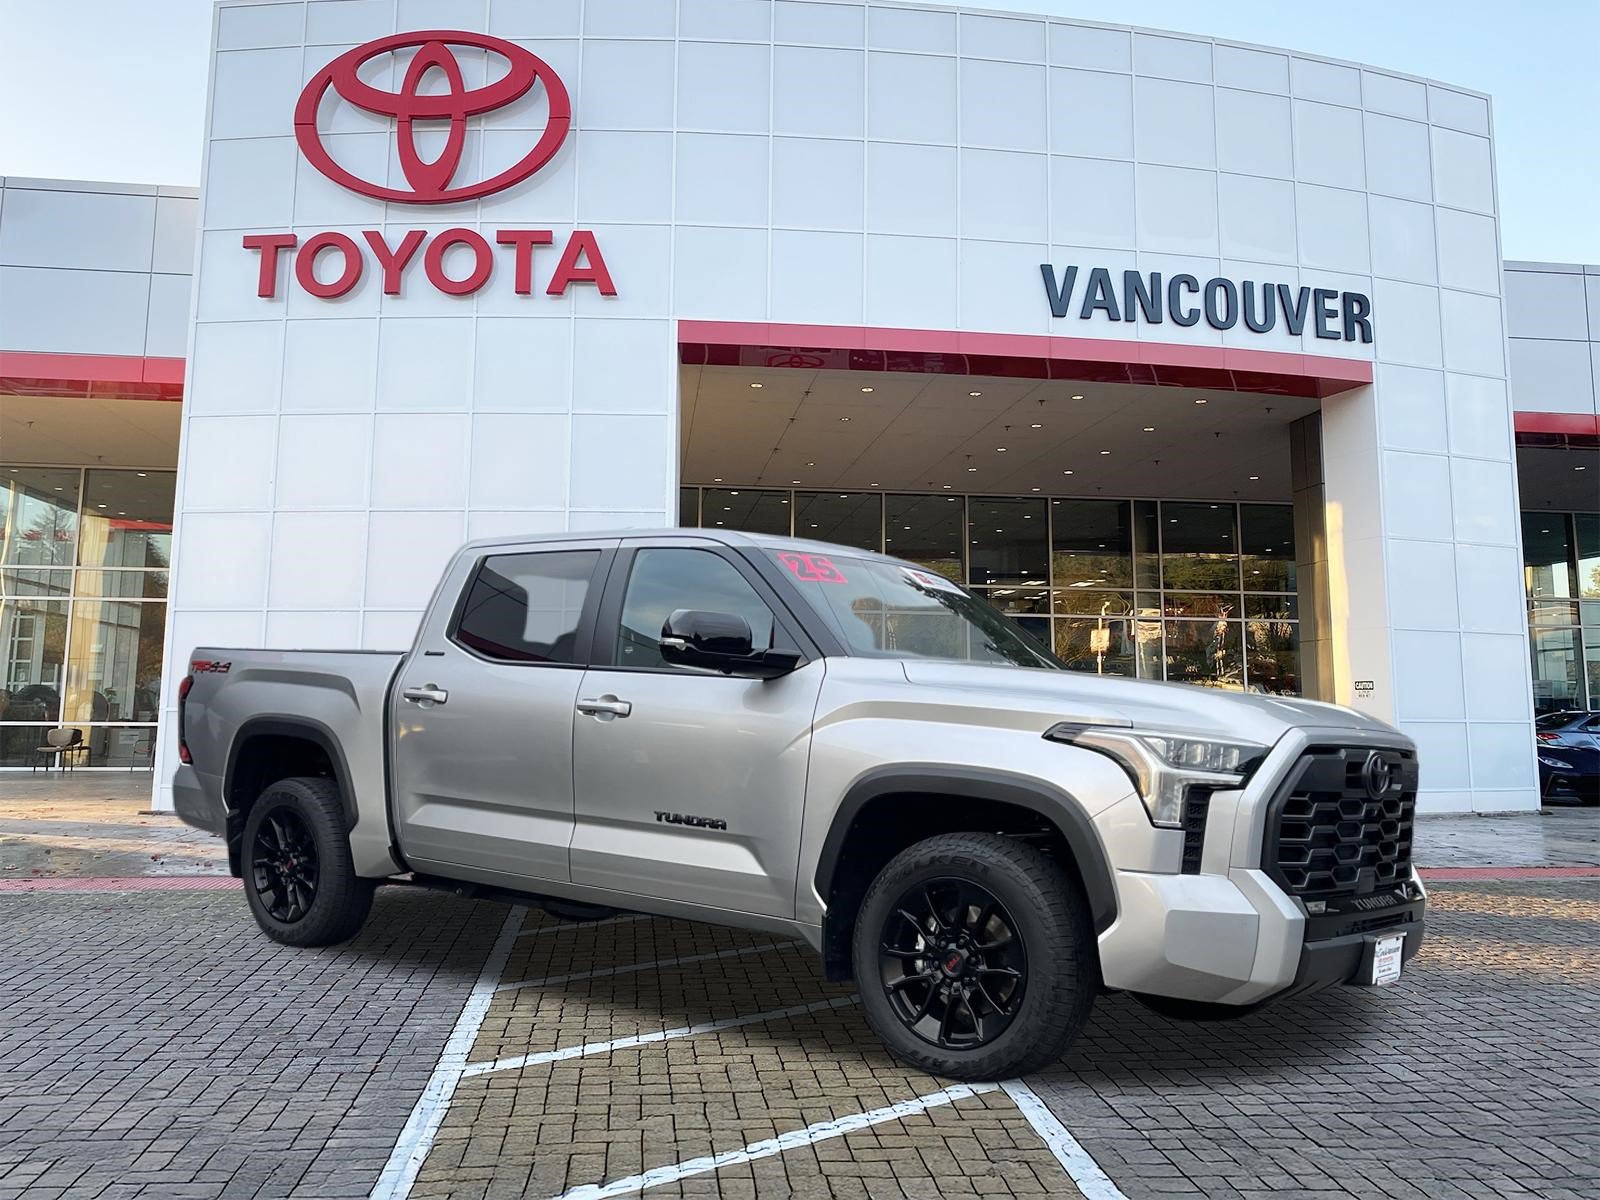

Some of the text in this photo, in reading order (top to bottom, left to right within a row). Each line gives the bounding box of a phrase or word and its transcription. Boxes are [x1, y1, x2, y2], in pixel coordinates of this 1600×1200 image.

[242, 227, 618, 299] TOYOTA
[1040, 264, 1374, 344] VANCOUVER
[783, 553, 839, 580] 25
[653, 811, 727, 831] TUNDRA
[1350, 895, 1398, 911] TUNDRA
